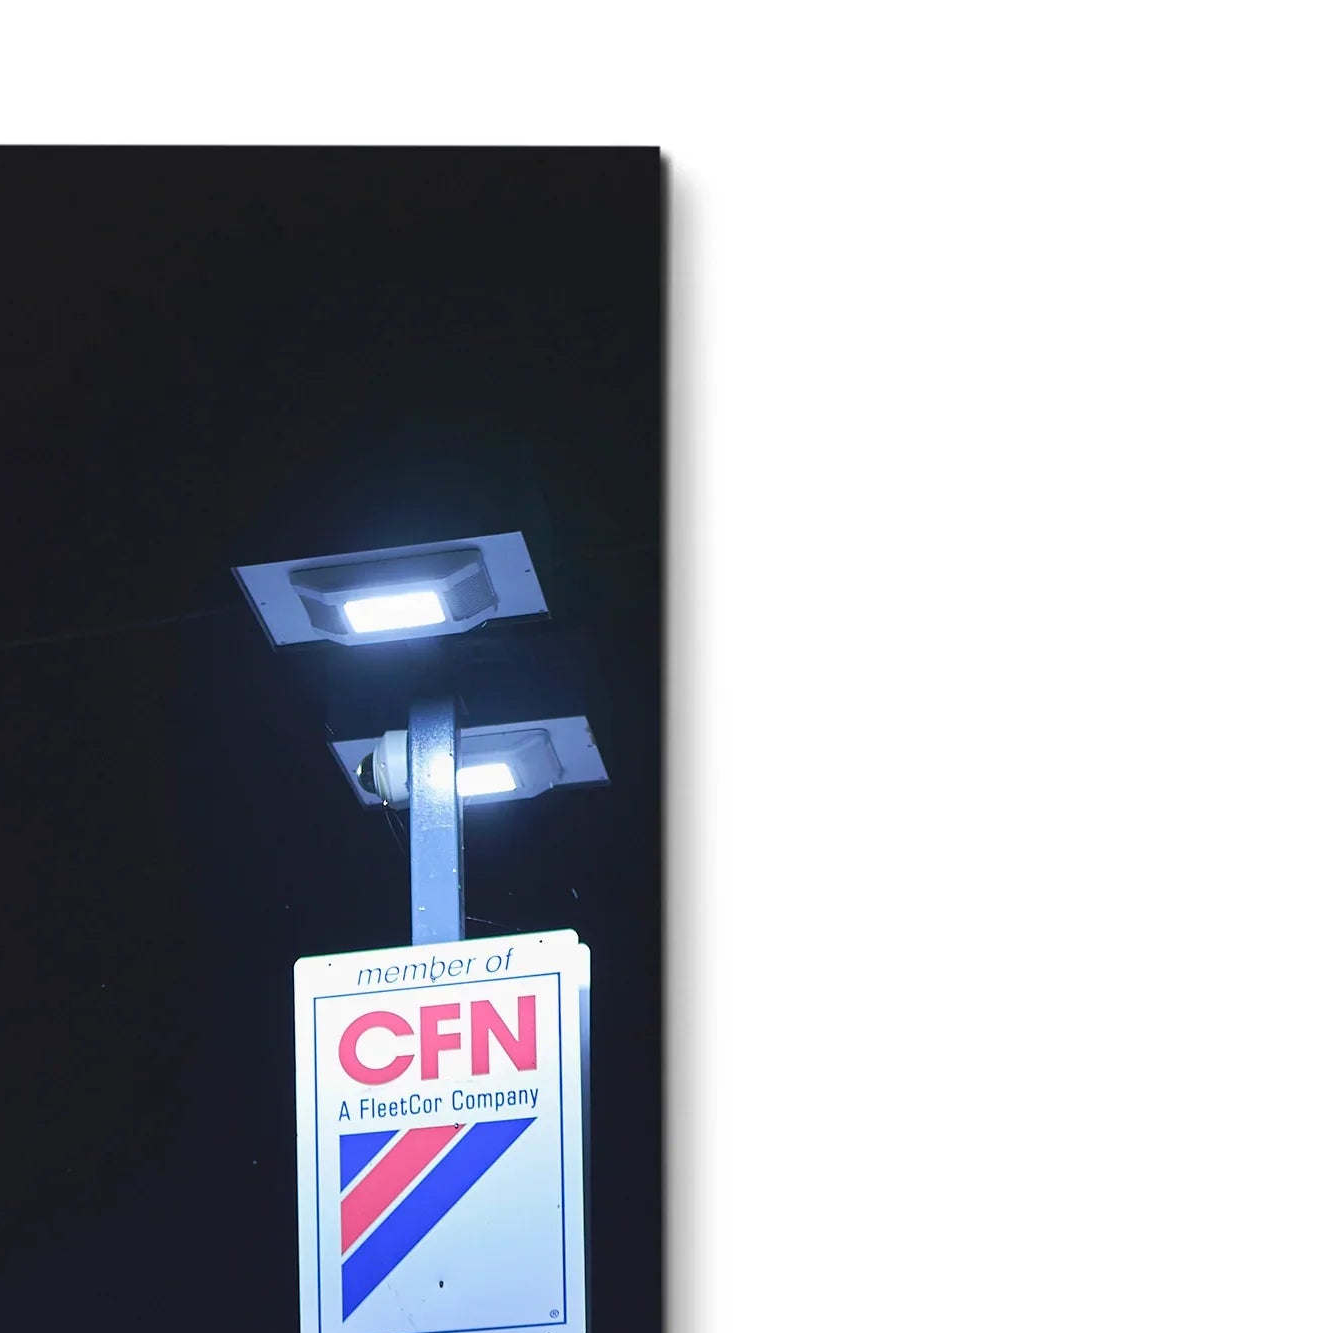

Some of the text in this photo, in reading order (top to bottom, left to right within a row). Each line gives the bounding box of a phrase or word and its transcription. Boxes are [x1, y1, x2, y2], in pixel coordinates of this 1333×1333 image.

[356, 947, 515, 987] member of
[338, 995, 538, 1086] CFN
[338, 1087, 540, 1122] A FleetCor Company
